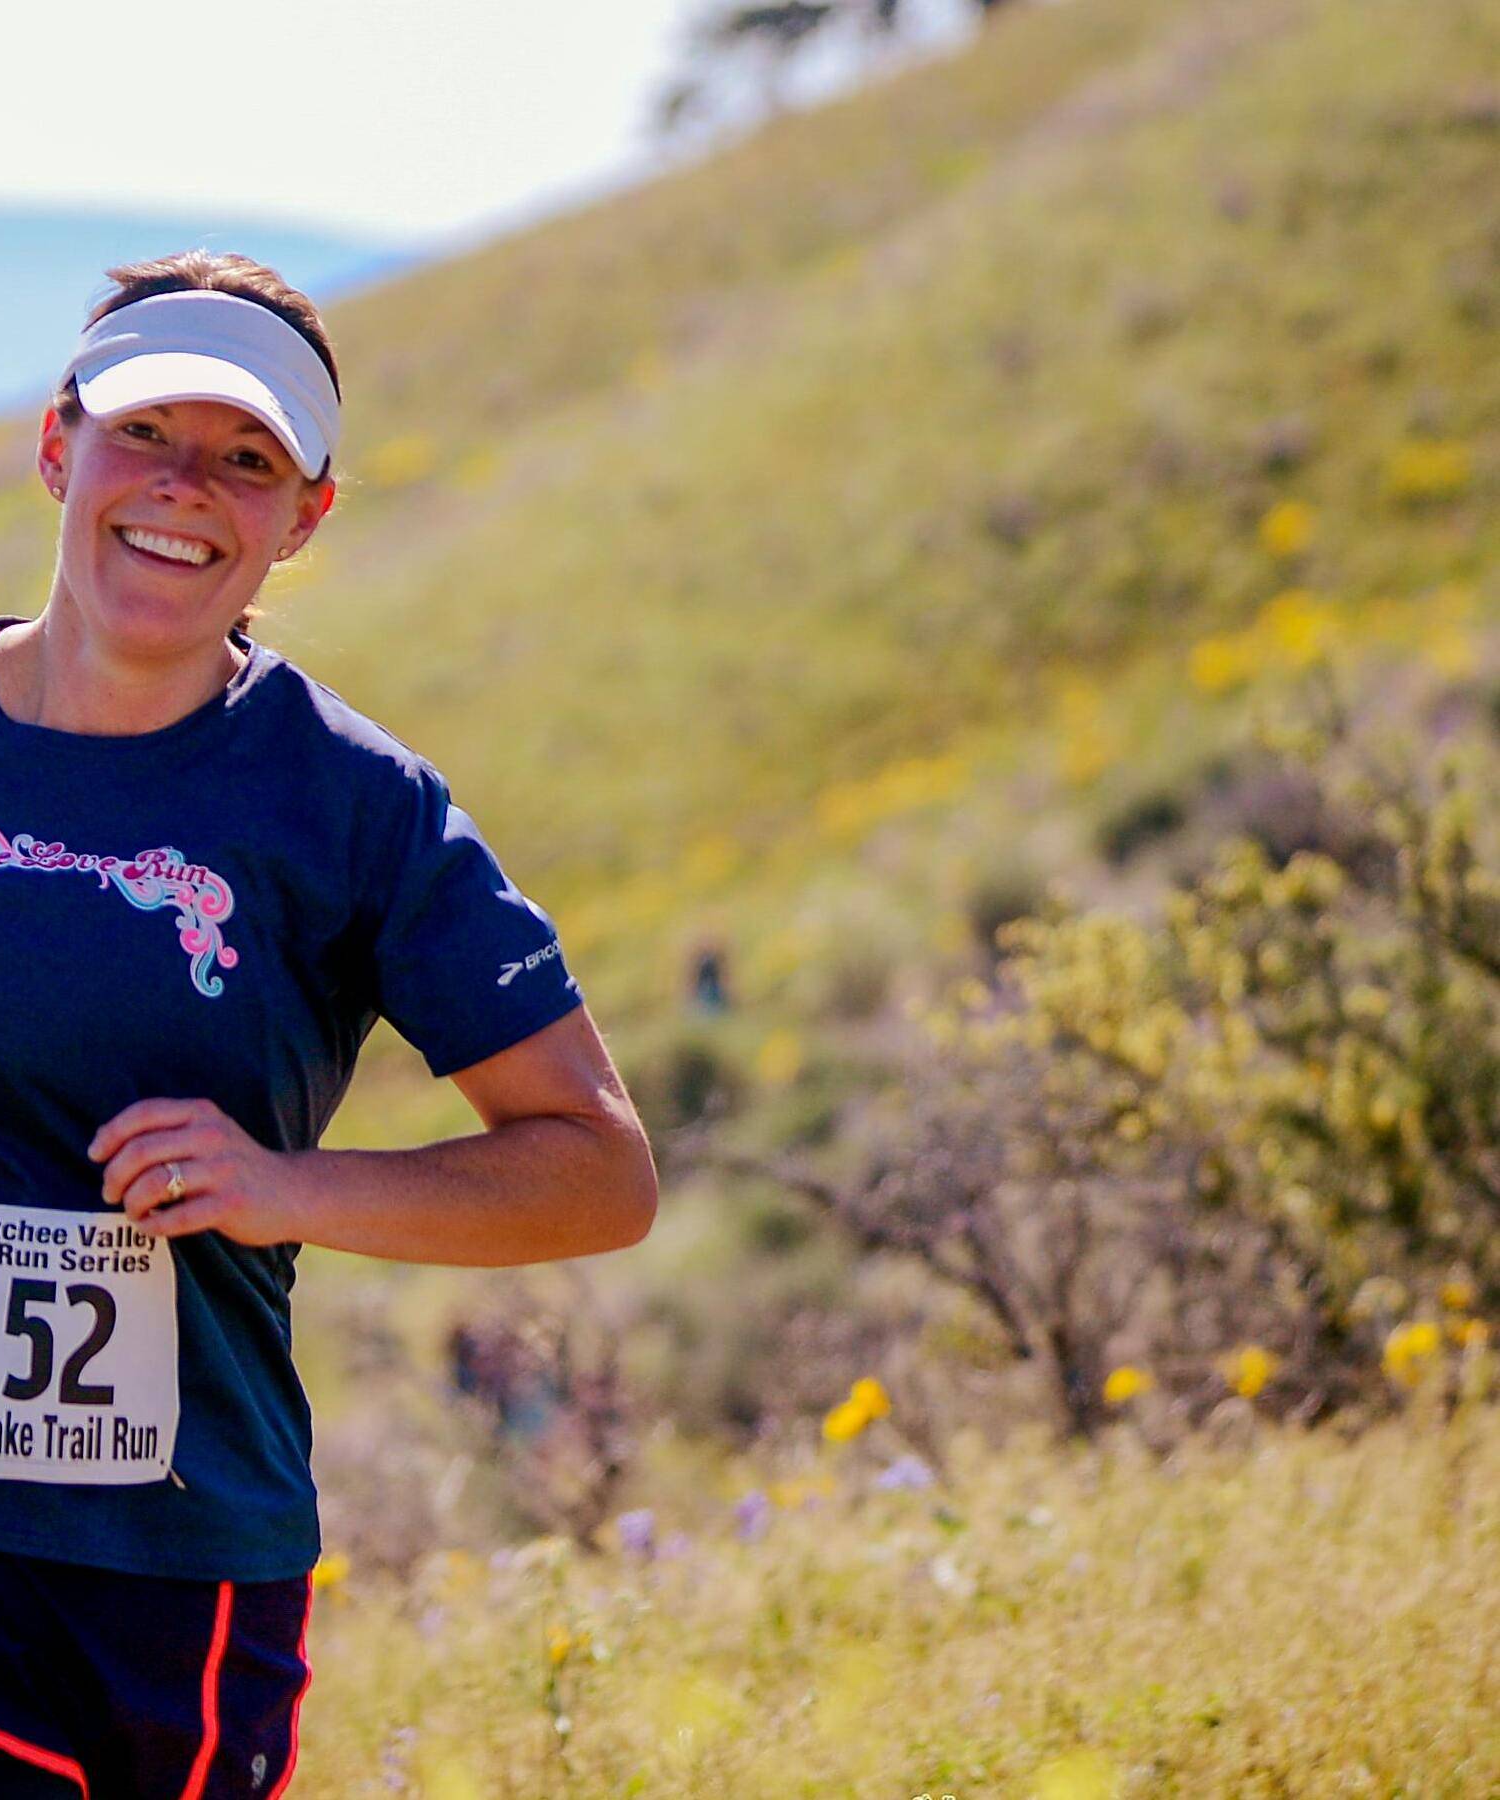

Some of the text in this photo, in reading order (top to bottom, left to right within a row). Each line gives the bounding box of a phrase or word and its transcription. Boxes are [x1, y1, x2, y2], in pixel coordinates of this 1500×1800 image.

[20, 840, 117, 870] Love
[122, 849, 207, 885] Run
[78, 1224, 156, 1251] Valley
[60, 1249, 150, 1273] Series
[44, 1414, 102, 1460] Trail
[112, 1416, 158, 1461] Run
